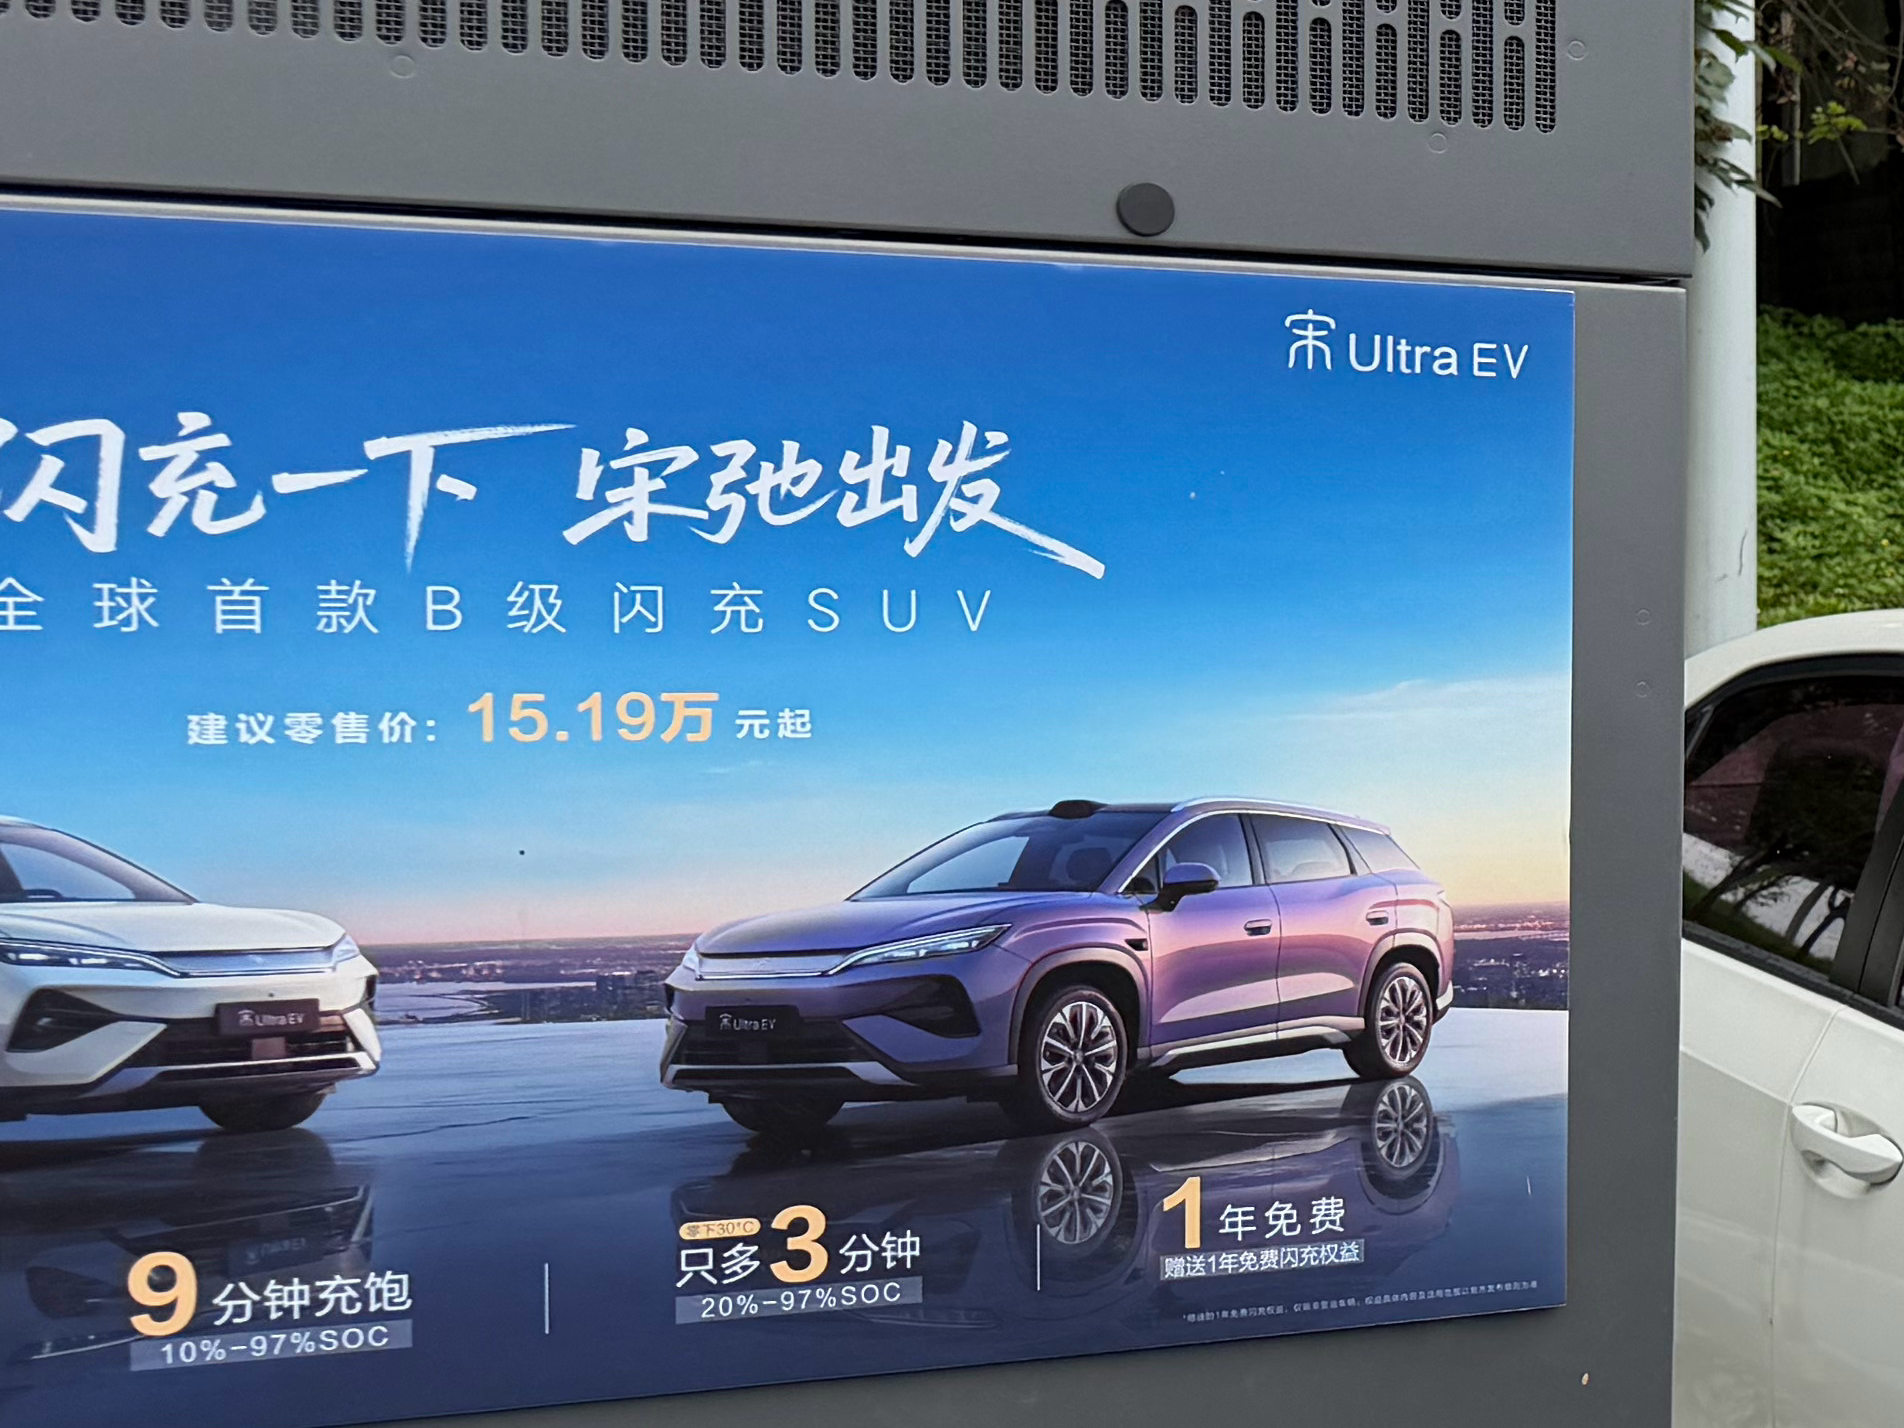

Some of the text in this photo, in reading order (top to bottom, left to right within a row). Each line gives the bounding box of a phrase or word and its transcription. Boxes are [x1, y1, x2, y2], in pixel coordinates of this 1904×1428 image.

[1349, 333, 1458, 376] Ultra
[1473, 343, 1529, 379] EV
[0, 411, 1105, 580] 闪充一下 宋弛出发
[0, 576, 991, 634] 全球首款B级闪充SUV
[1164, 1241, 1361, 1279] 赠送1年免费闪充权益
[701, 1282, 901, 1318] 20%-97%SOC
[161, 1325, 389, 1364] 10%-97%SOC
